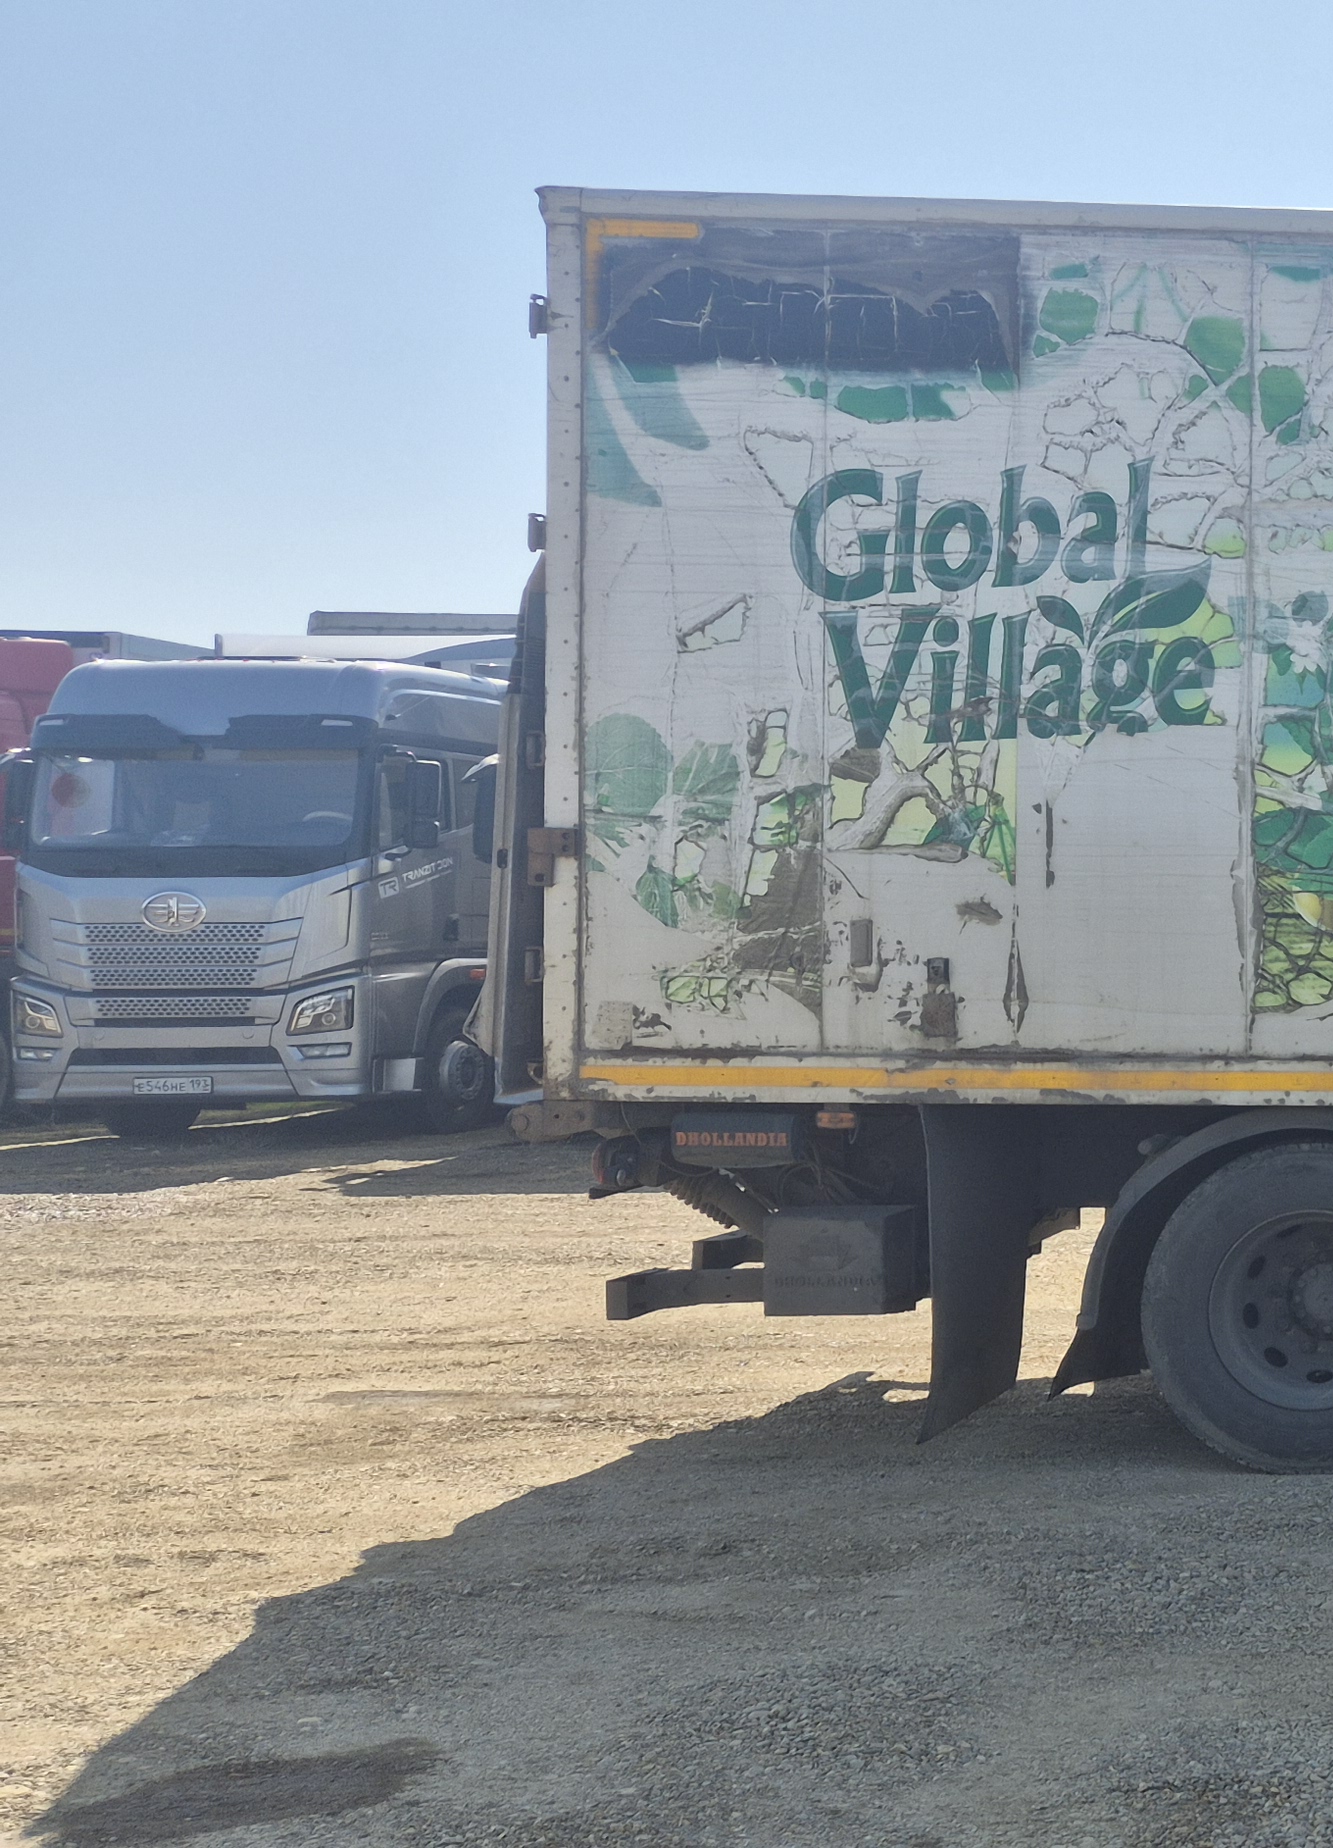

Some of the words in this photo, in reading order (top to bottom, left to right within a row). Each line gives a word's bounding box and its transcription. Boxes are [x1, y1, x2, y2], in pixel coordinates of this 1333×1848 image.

[790, 455, 1156, 602] Global
[818, 605, 1216, 749] Village
[675, 1131, 788, 1147] DHOLLANDIA
